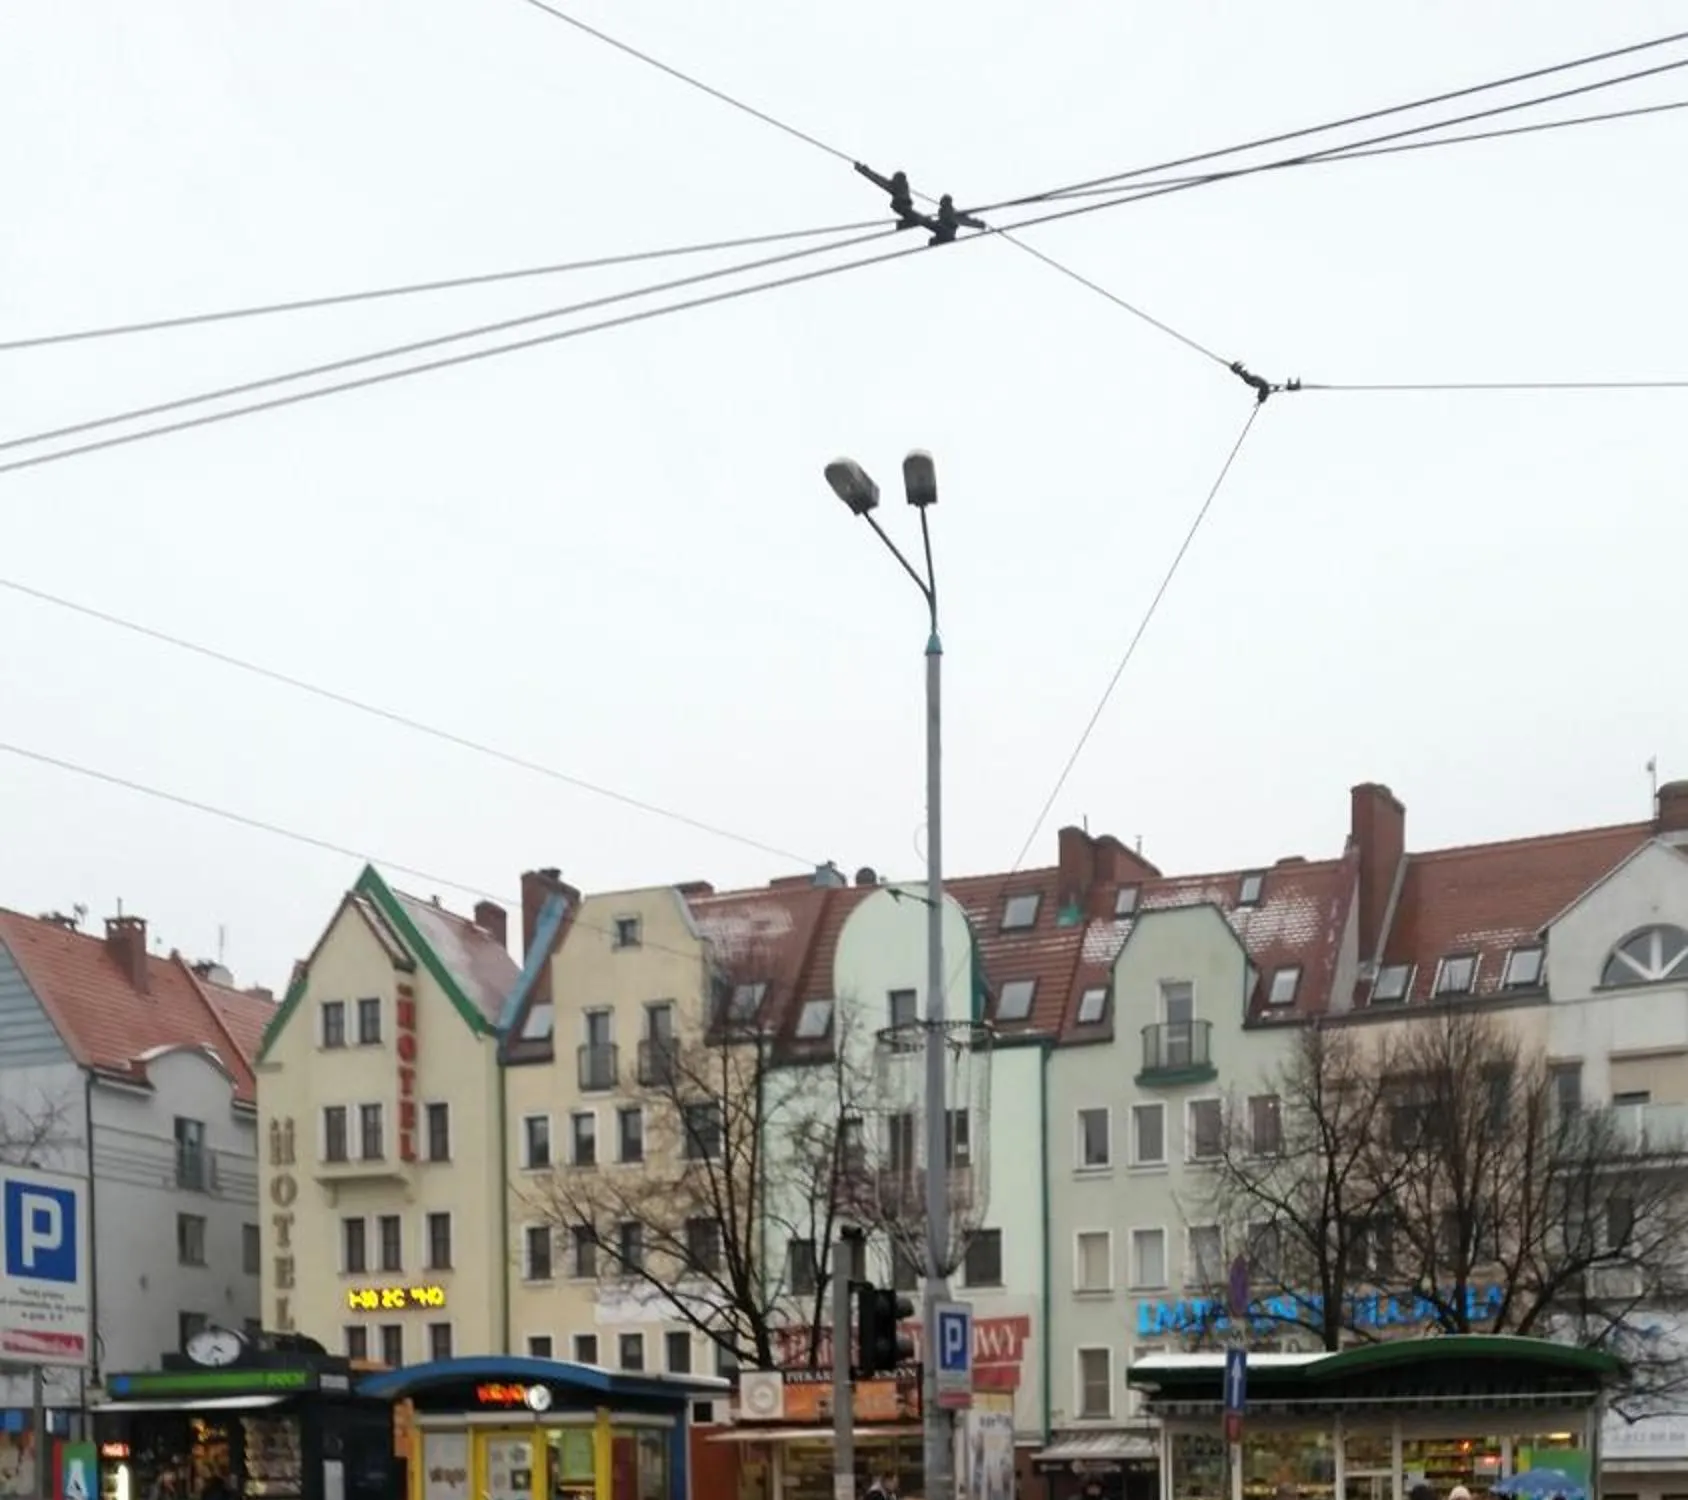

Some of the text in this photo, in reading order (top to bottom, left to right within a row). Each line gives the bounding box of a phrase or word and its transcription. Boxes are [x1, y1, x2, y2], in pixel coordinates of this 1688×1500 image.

[397, 984, 417, 1161] HOTEL
[21, 1191, 63, 1268] P
[270, 1117, 297, 1331] HOTEL
[944, 1316, 963, 1364] P
